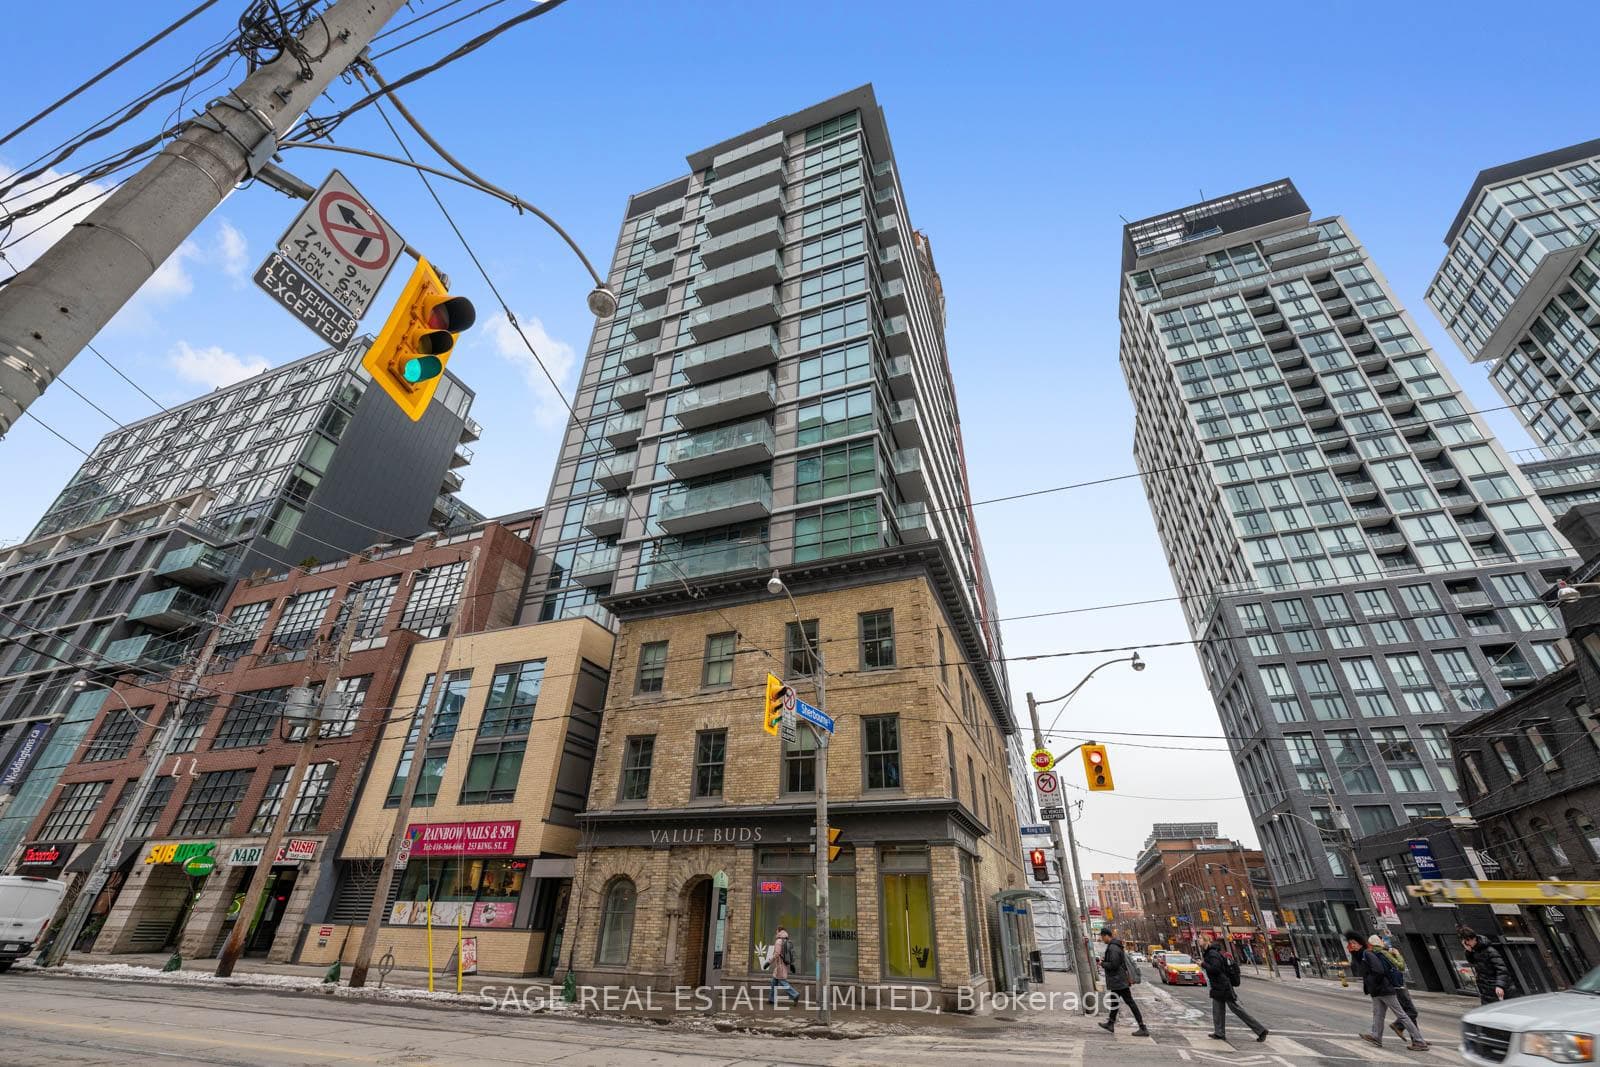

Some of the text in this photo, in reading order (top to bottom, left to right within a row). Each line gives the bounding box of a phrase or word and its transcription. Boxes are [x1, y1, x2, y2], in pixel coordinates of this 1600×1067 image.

[305, 224, 318, 238] 7
[314, 241, 332, 258] AM
[344, 264, 357, 278] 9
[354, 279, 371, 294] AM
[294, 239, 309, 252] 4
[307, 252, 325, 270] PM
[338, 278, 350, 291] 6
[349, 290, 365, 306] PM
[294, 253, 323, 280] MON
[333, 287, 352, 307] FRI
[270, 256, 354, 335] TTC VEHICLES
[262, 274, 343, 343] EXCEPTED
[423, 825, 515, 840] RAINBOW NAILS & SPA
[650, 827, 762, 843] VALUE BUDS
[144, 840, 216, 865] SUBWAY
[232, 848, 262, 862] NARI
[289, 840, 316, 853] SUSHI
[829, 930, 857, 941] ANNABIS
